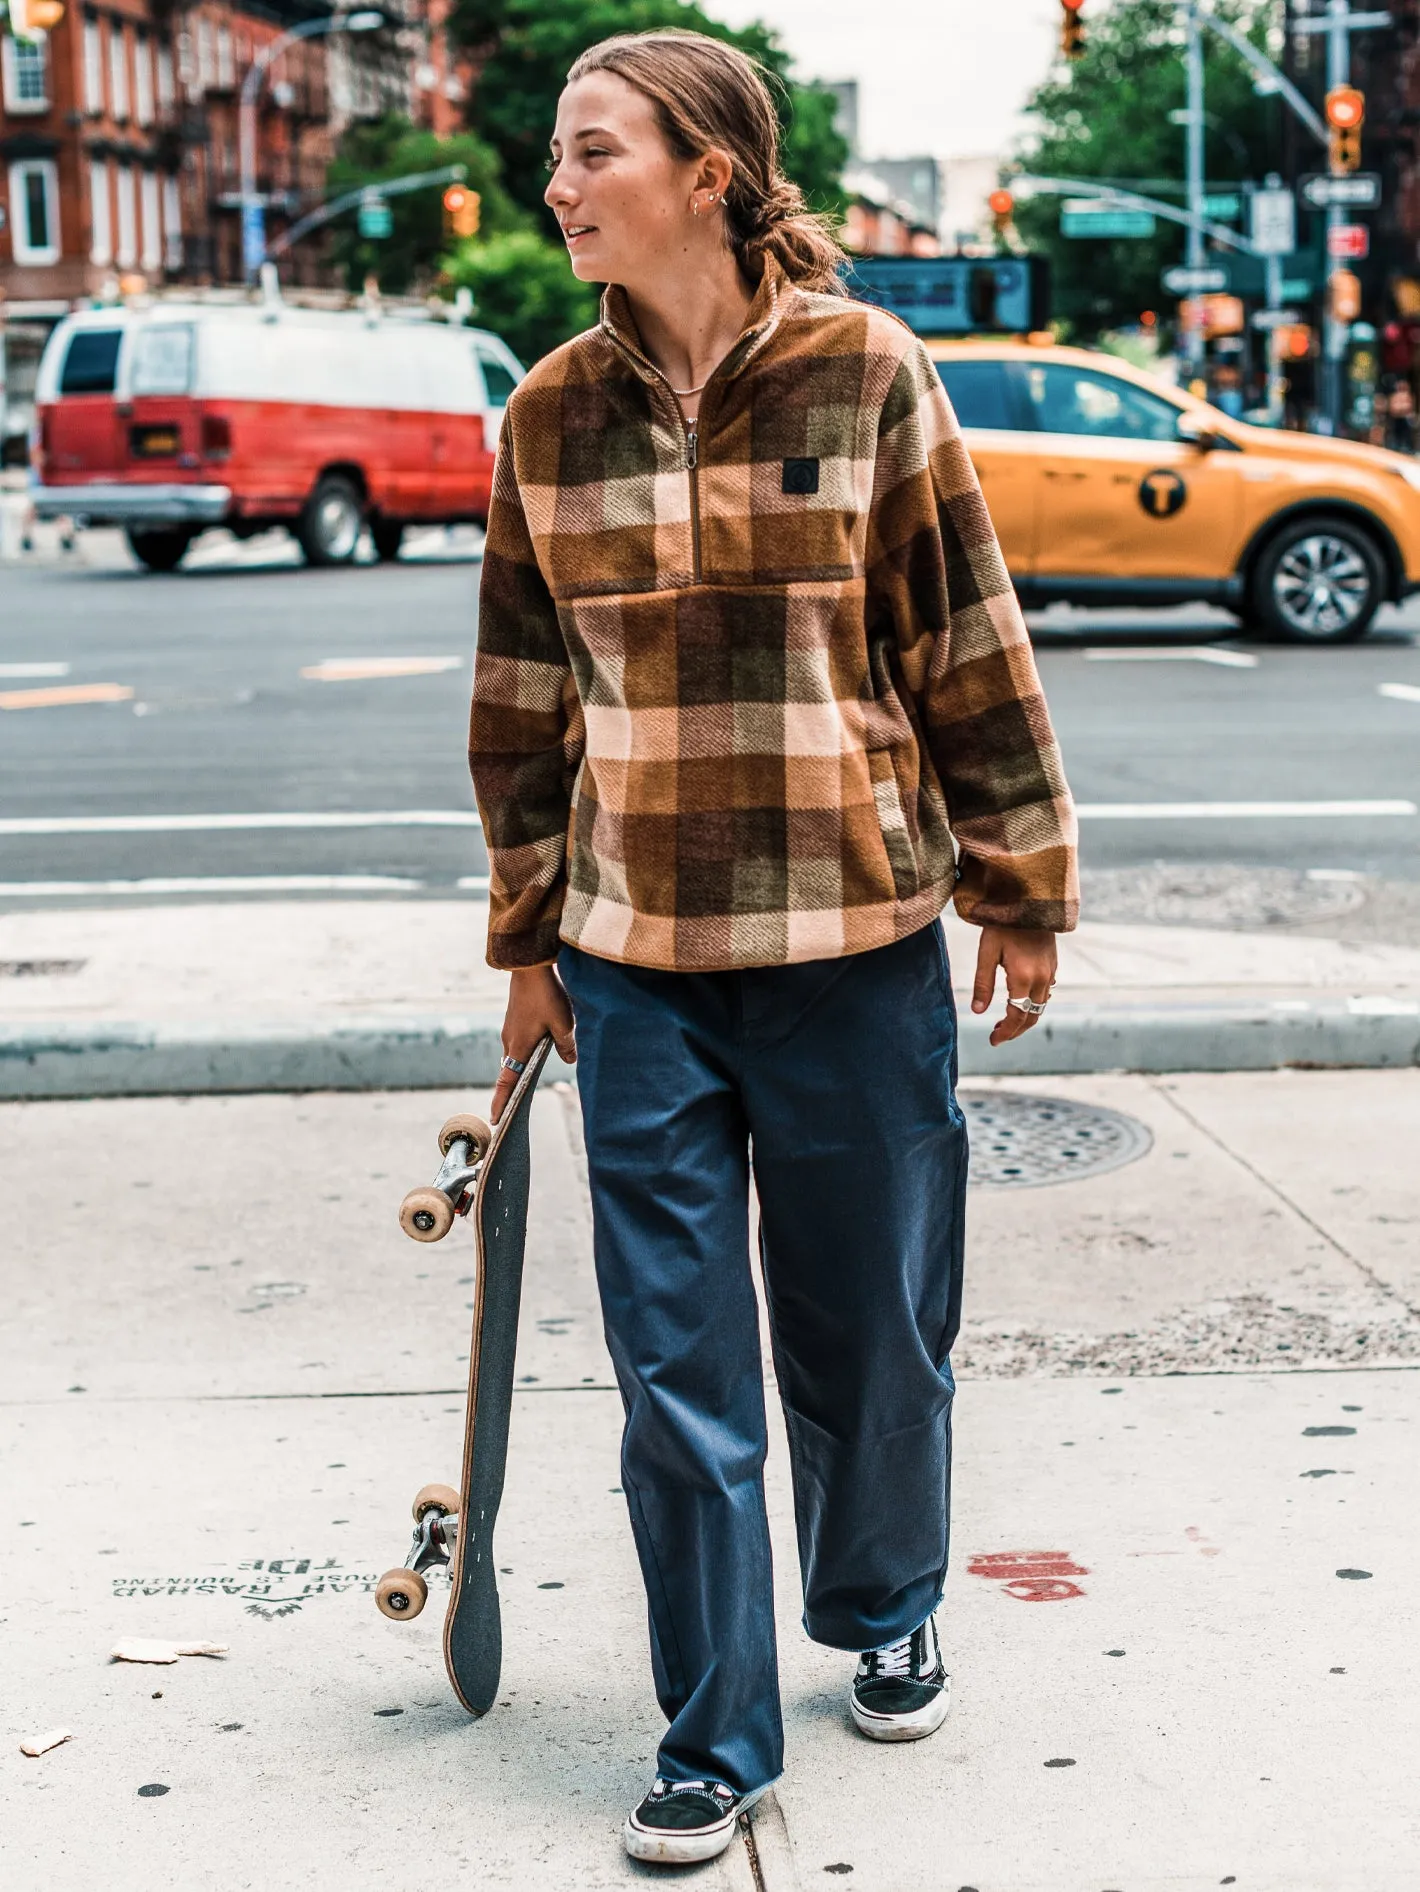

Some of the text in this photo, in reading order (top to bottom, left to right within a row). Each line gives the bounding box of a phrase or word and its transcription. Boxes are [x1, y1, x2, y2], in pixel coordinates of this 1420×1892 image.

[1147, 475, 1179, 512] T
[237, 1558, 344, 1574] TDE
[112, 1577, 235, 1586] BURNING
[256, 1576, 285, 1584] IS
[311, 1574, 378, 1582] OUSE
[113, 1585, 271, 1597] RASHAD
